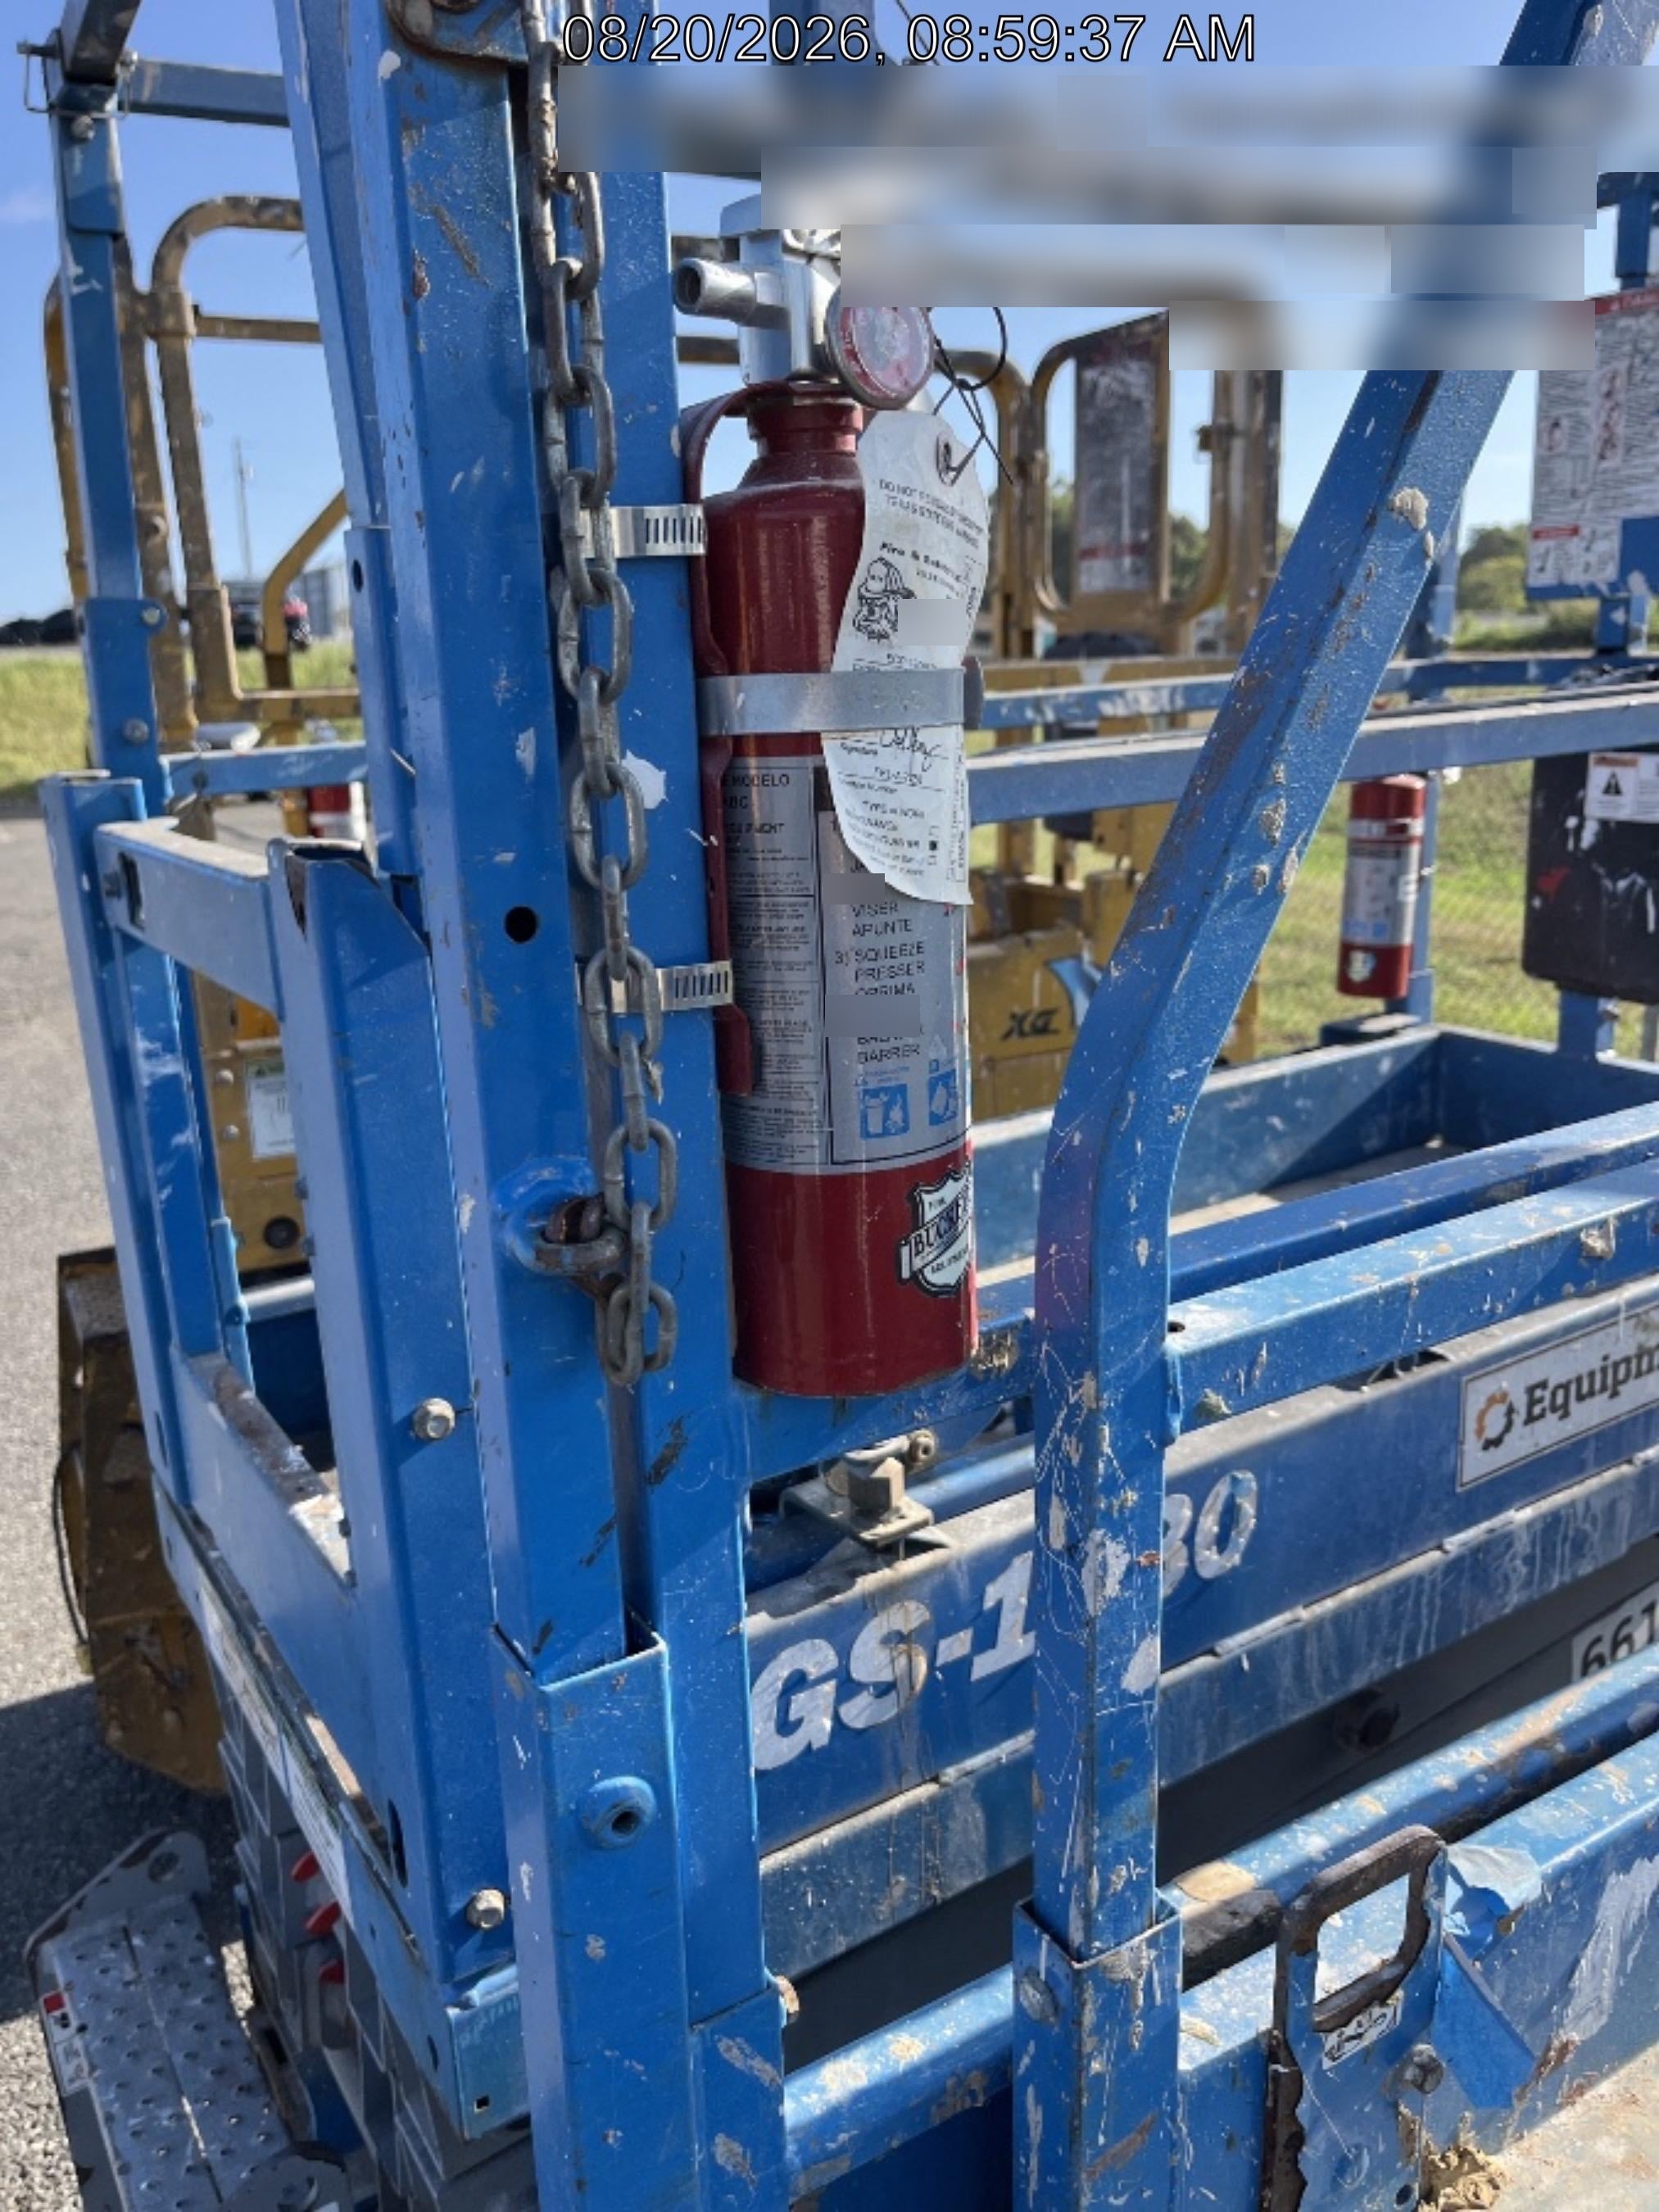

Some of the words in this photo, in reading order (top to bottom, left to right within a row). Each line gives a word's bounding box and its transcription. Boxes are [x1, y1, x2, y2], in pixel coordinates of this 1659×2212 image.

[852, 918, 913, 938] APUNTE
[854, 941, 926, 964] SQUEEZE
[854, 960, 926, 983] PRESSER
